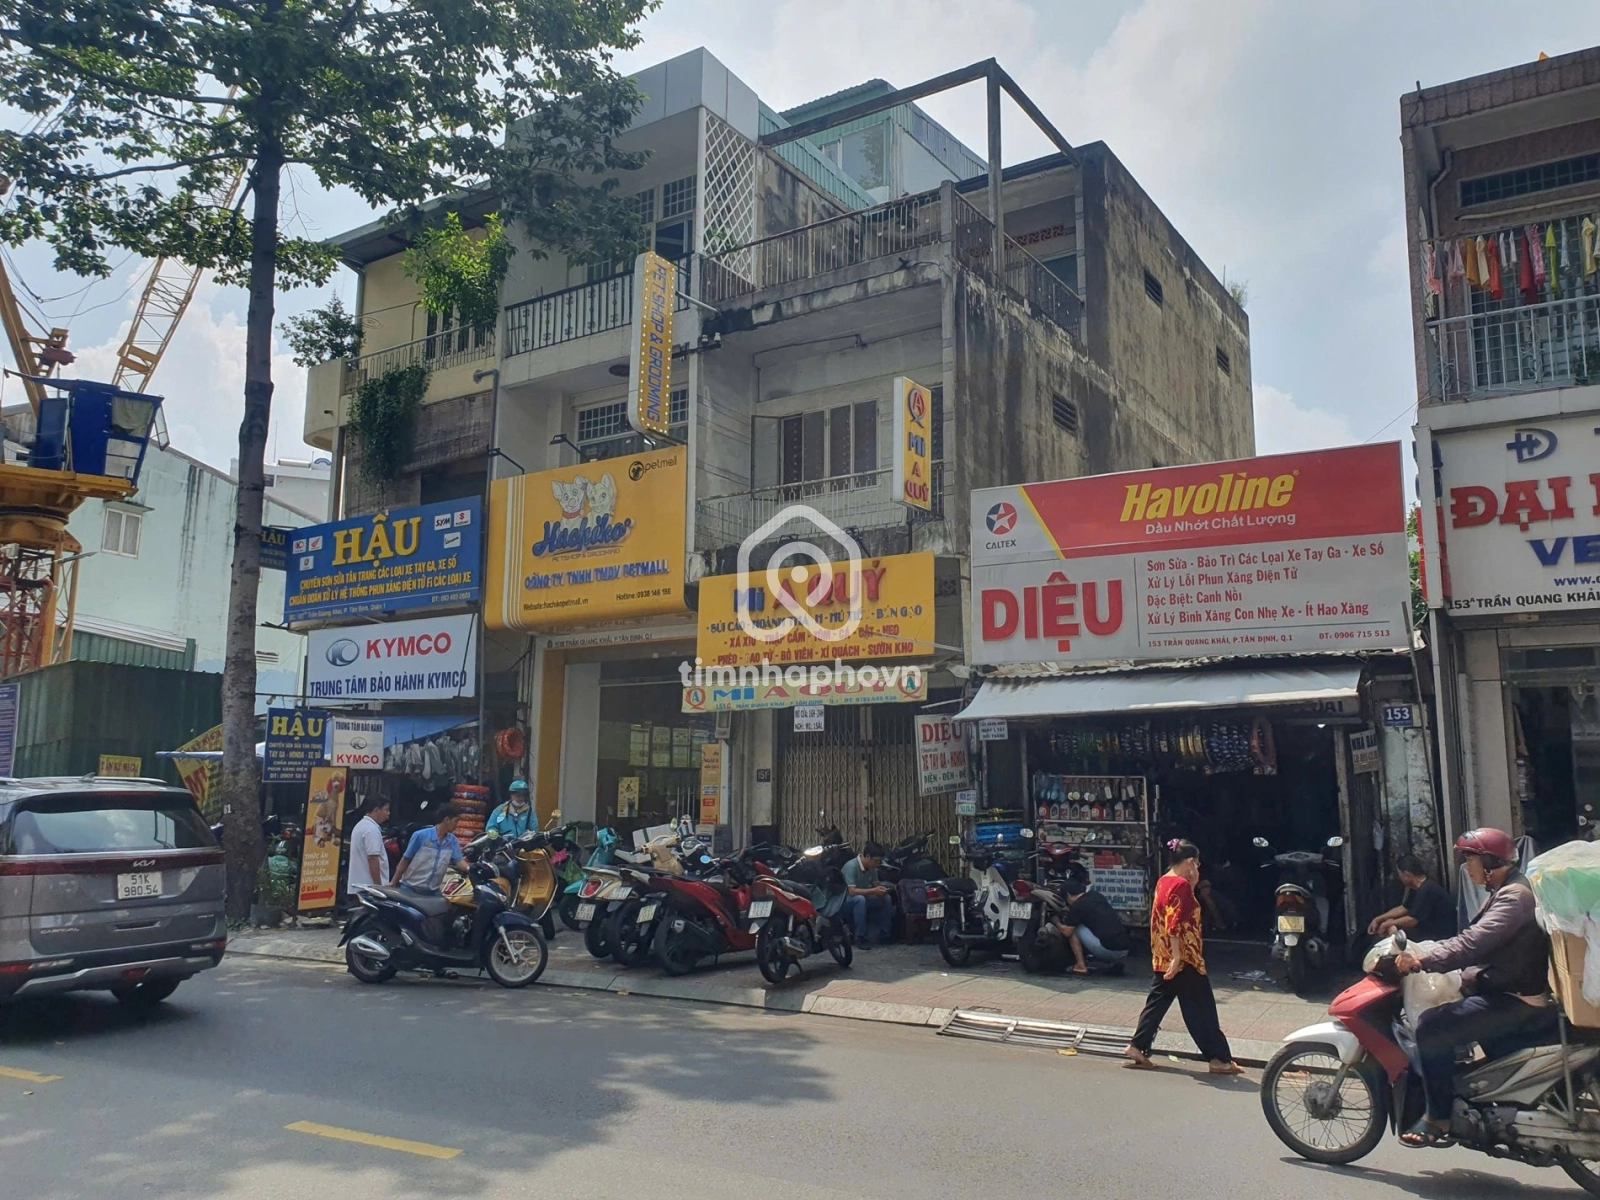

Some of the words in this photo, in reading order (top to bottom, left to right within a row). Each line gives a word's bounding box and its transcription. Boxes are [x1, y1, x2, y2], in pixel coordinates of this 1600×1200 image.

[653, 263, 667, 294] PET
[651, 292, 666, 332] SHOP
[650, 334, 663, 344] &
[647, 347, 663, 423] GROOMING
[645, 455, 677, 473] petmall
[1120, 472, 1294, 523] Havoline
[1451, 476, 1574, 532] ĐẠI
[436, 517, 450, 527] SYM
[1144, 519, 1172, 535] Dầu
[1174, 517, 1209, 533] Nhớt
[1211, 513, 1243, 529] Chất
[1246, 511, 1296, 529] Lượng
[332, 514, 422, 567] HẬU
[985, 538, 1017, 550] CALTEX
[587, 548, 620, 558] GROOMING
[1147, 560, 1165, 572] Sơn
[1168, 557, 1187, 570] Sửa
[1197, 555, 1217, 568] Bảo
[1220, 554, 1235, 567] Trì
[1239, 552, 1258, 565] Các
[1288, 549, 1301, 562] Xe
[1304, 548, 1323, 562] Tay
[1327, 546, 1341, 559] Ga
[1352, 544, 1366, 557] Xe
[1370, 541, 1384, 556] Số
[346, 571, 356, 584] TÂN
[359, 570, 376, 582] TRANG
[378, 567, 389, 579] CÁC
[391, 566, 404, 579] LOẠI
[405, 564, 413, 575] XE
[415, 561, 426, 573] TAY
[427, 561, 436, 573] GA,
[438, 559, 446, 570] XE
[448, 553, 457, 569] SỐ
[525, 572, 551, 590] CÔNG
[551, 574, 564, 586] TY
[567, 568, 593, 584] TNHH
[623, 559, 670, 578] PETMALL
[1148, 576, 1161, 589] Xử
[1164, 576, 1175, 590] Lý
[1179, 573, 1195, 587] Lỗi
[1198, 573, 1223, 586] Phun
[1227, 571, 1253, 585] Xăng
[1256, 569, 1280, 584] Điện
[1283, 566, 1298, 580] Tử
[331, 588, 339, 601] LÝ
[340, 586, 348, 601] HỆ
[349, 583, 368, 598] THỐNG
[369, 584, 385, 597] PHUN
[385, 581, 401, 594] XĂNG
[403, 577, 416, 593] ĐIỆN
[417, 574, 426, 589] TỬ
[434, 574, 446, 588] CÁC
[447, 573, 461, 587] LOẠI
[463, 571, 472, 583] XE
[773, 578, 798, 609] A
[1147, 594, 1166, 609] Đặc
[1169, 593, 1193, 608] Biệt:
[1196, 590, 1222, 604] Canh
[1225, 587, 1242, 602] Nồi
[981, 571, 1125, 652] DIỆU
[1476, 594, 1512, 609] TRẦN
[1516, 593, 1562, 606] QUANG
[1147, 611, 1161, 625] Xử
[1164, 612, 1175, 626] Lý
[1179, 611, 1202, 623] Bình
[1205, 609, 1231, 623] Xăng
[1235, 608, 1254, 620] Con
[1258, 607, 1277, 621] Nhẹ
[1281, 605, 1295, 618] Xe
[1305, 601, 1314, 617] Ít
[1317, 603, 1338, 616] Hao
[1341, 602, 1369, 616] Xăng
[366, 632, 452, 660] KYMCO
[730, 635, 741, 648] XÁ
[883, 624, 899, 636] HEO
[1148, 640, 1161, 648] 153
[1164, 637, 1182, 647] TRẦN
[1185, 638, 1209, 646] QUANG
[1211, 635, 1231, 645] KHẢI,
[1233, 634, 1255, 644] P.TÂN
[1258, 635, 1279, 644] ĐỊNH,
[1281, 634, 1293, 642] Q.1
[1334, 631, 1354, 639] 0906
[1357, 630, 1372, 638] 715
[1375, 629, 1390, 637] 513
[718, 653, 737, 665] PHÈO
[781, 648, 791, 661] BÒ
[794, 647, 813, 661] VIÊN
[820, 645, 829, 659] XÍ
[832, 645, 859, 659] QUÁCH
[868, 641, 892, 656] SƯỜN
[895, 642, 913, 653] KHO
[310, 681, 342, 698] TRUNG
[345, 675, 367, 696] TÂM
[370, 671, 392, 693] BẢO
[395, 670, 424, 692] HÀNH
[427, 671, 467, 690] KYMCO
[764, 685, 790, 699] A
[1386, 707, 1410, 720] 153
[271, 711, 324, 741] HẬU
[921, 717, 962, 748] DIỆU
[269, 751, 278, 759] TAY
[279, 751, 286, 759] GA
[308, 751, 314, 759] XE
[336, 754, 380, 765] KYMCO
[924, 772, 938, 785] ĐIỆN
[124, 885, 159, 897] 980.54
[131, 874, 151, 885] 51K
